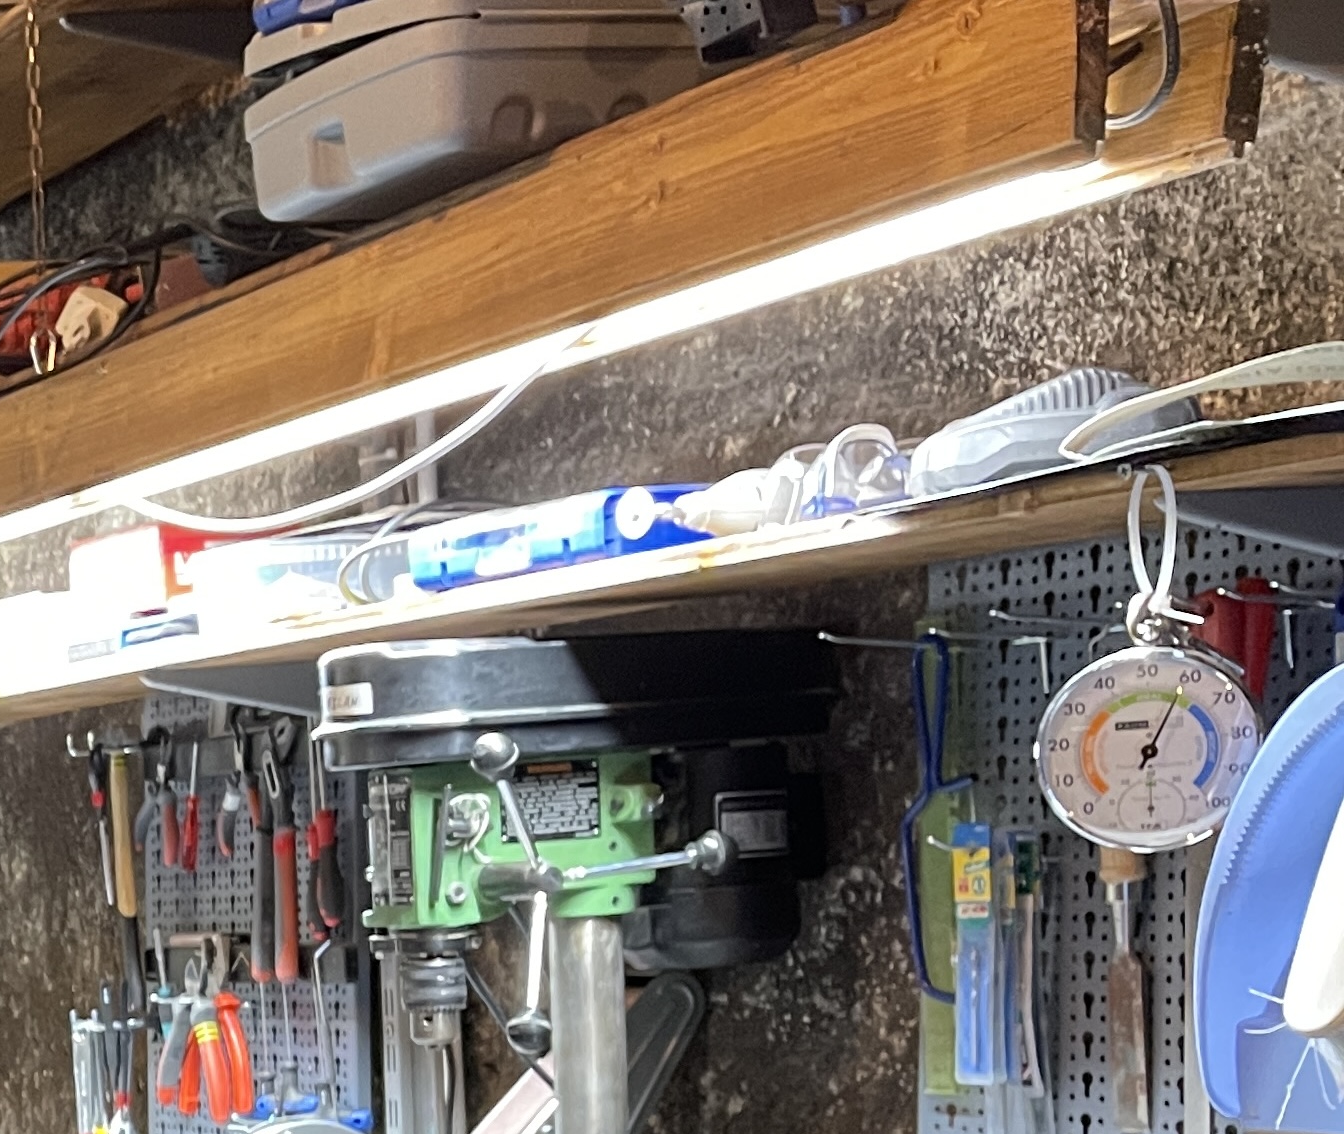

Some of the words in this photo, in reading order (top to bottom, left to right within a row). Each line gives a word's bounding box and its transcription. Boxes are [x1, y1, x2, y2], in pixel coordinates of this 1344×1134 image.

[1136, 664, 1158, 678] 50
[1179, 669, 1201, 684] 60
[1093, 676, 1115, 690] 40
[1213, 691, 1236, 706] 70
[1063, 702, 1086, 716] 30
[1231, 725, 1253, 740] 80
[1048, 738, 1070, 752] 20
[1054, 774, 1074, 788] 10
[1083, 802, 1094, 815] 0
